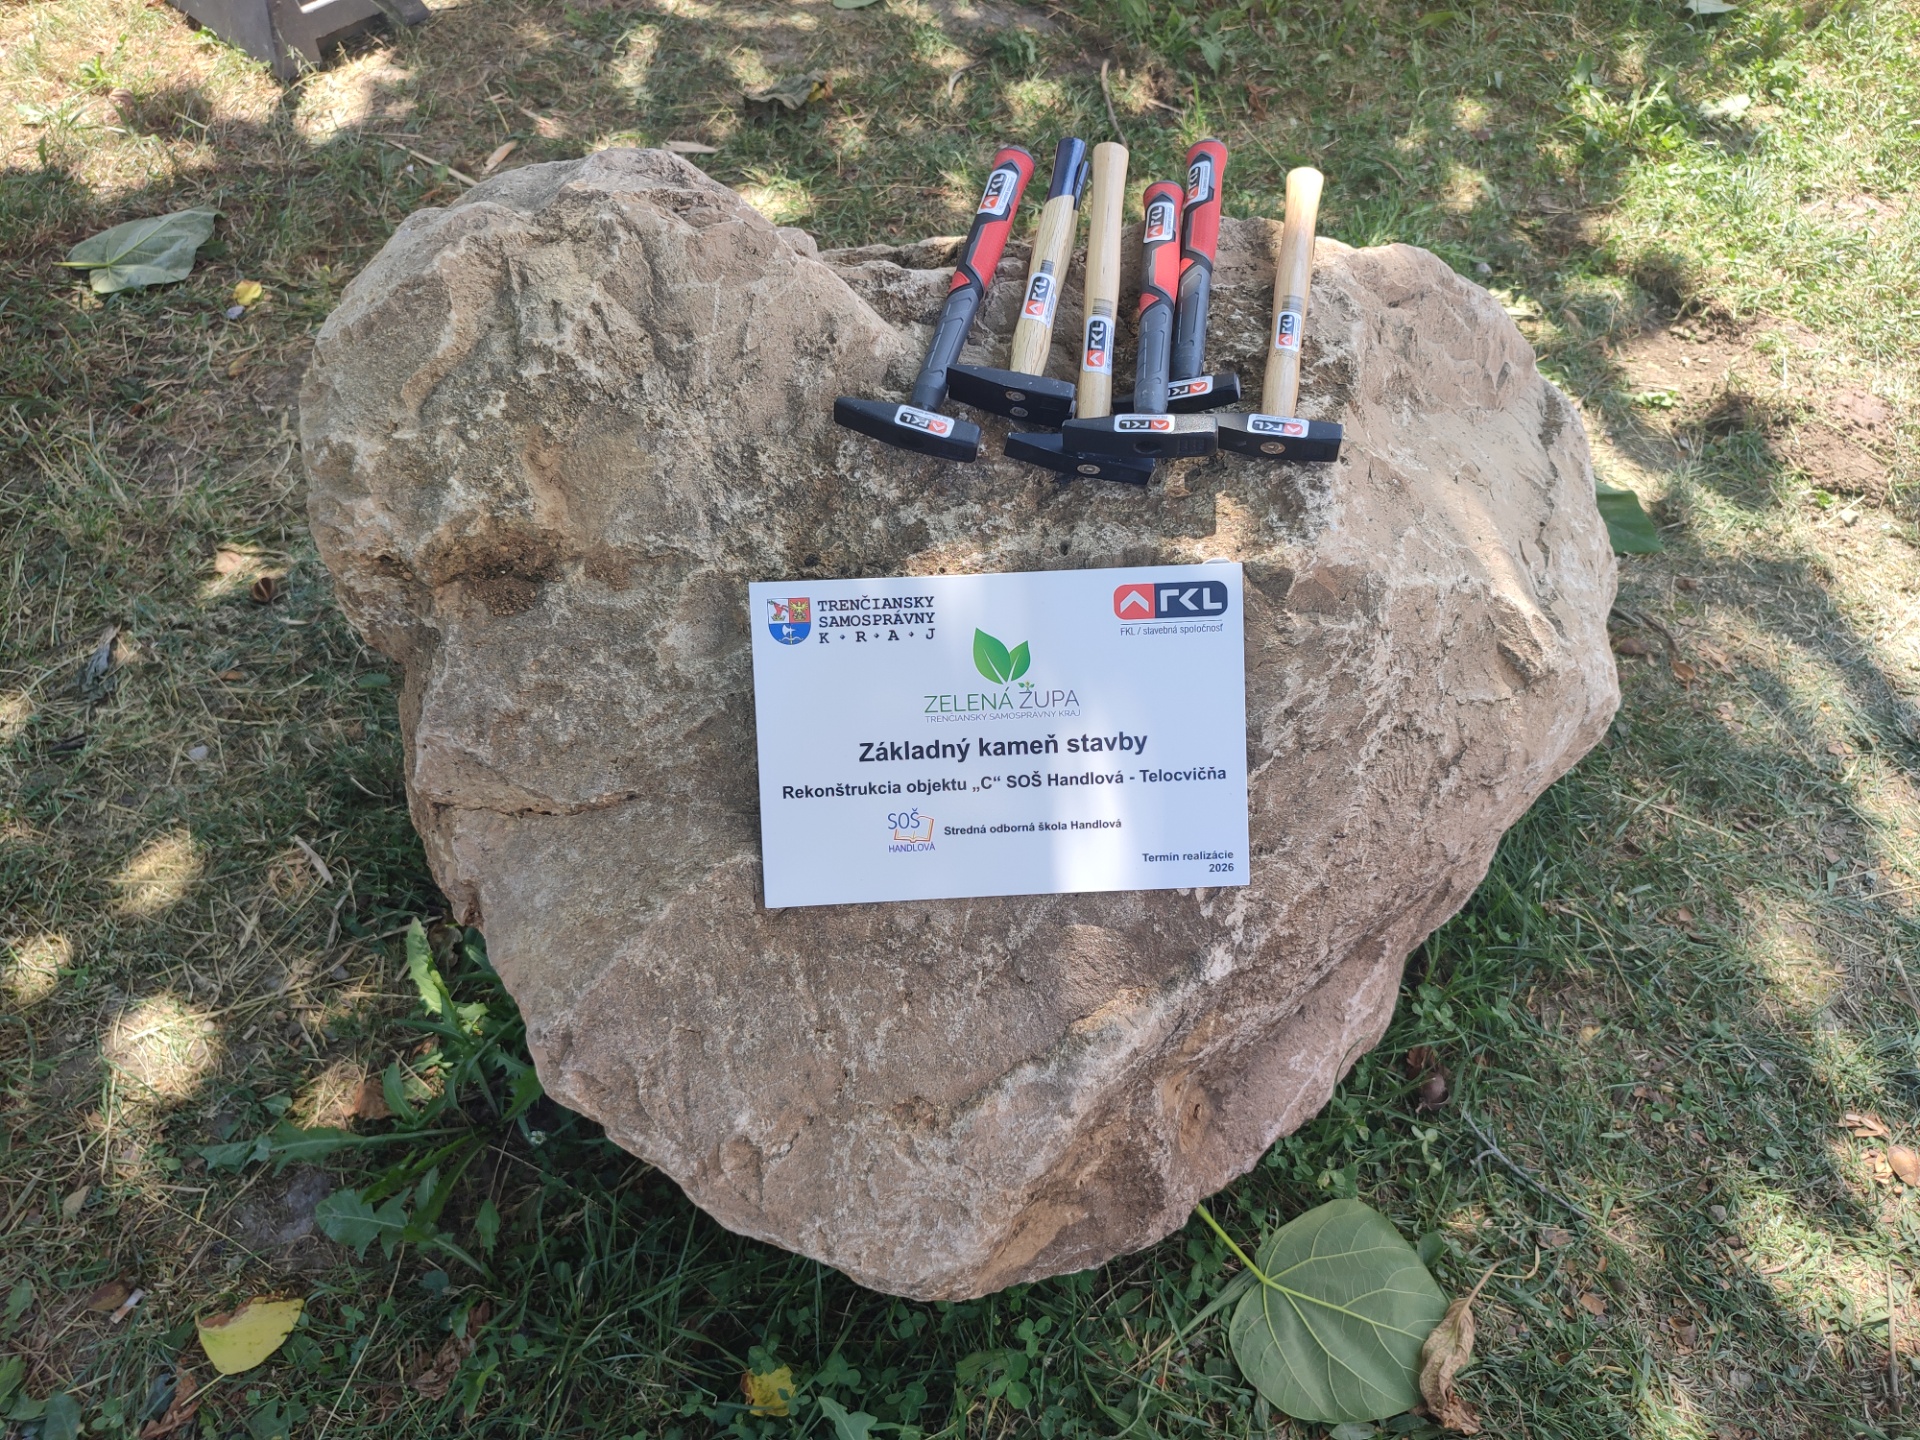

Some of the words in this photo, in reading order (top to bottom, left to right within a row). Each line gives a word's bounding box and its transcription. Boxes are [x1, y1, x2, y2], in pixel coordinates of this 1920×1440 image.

[818, 595, 935, 611] TRENČIANSKY
[819, 610, 936, 627] SAMOSPRÁVNY
[1120, 627, 1135, 636] FKL
[1143, 624, 1178, 635] stavebná
[1180, 623, 1224, 636] spoločnosť
[924, 686, 1014, 713] ZELENÁ
[925, 712, 988, 723] TRENČIANSKY
[989, 709, 1056, 721] SAMOSPRÁVNY
[1058, 709, 1081, 718] KRAJ
[859, 738, 970, 762] Základný
[978, 734, 1059, 757] kameň
[1067, 732, 1147, 755] stavby
[782, 781, 901, 799] Rekonštrukcia
[907, 777, 967, 795] objektu
[1007, 771, 1042, 788] SOŠ
[1047, 770, 1124, 787] Handlová
[1139, 767, 1226, 783] Telocvičňa
[887, 807, 920, 830] SOŠ
[944, 824, 986, 836] Stredná
[990, 822, 1035, 834] odborná
[1038, 820, 1067, 832] škola
[1071, 819, 1121, 831] Handlová
[889, 841, 935, 853] HANDLOVÁ
[1142, 852, 1179, 863] Termín
[1182, 849, 1234, 861] realizácie
[1209, 863, 1234, 873] 2026
